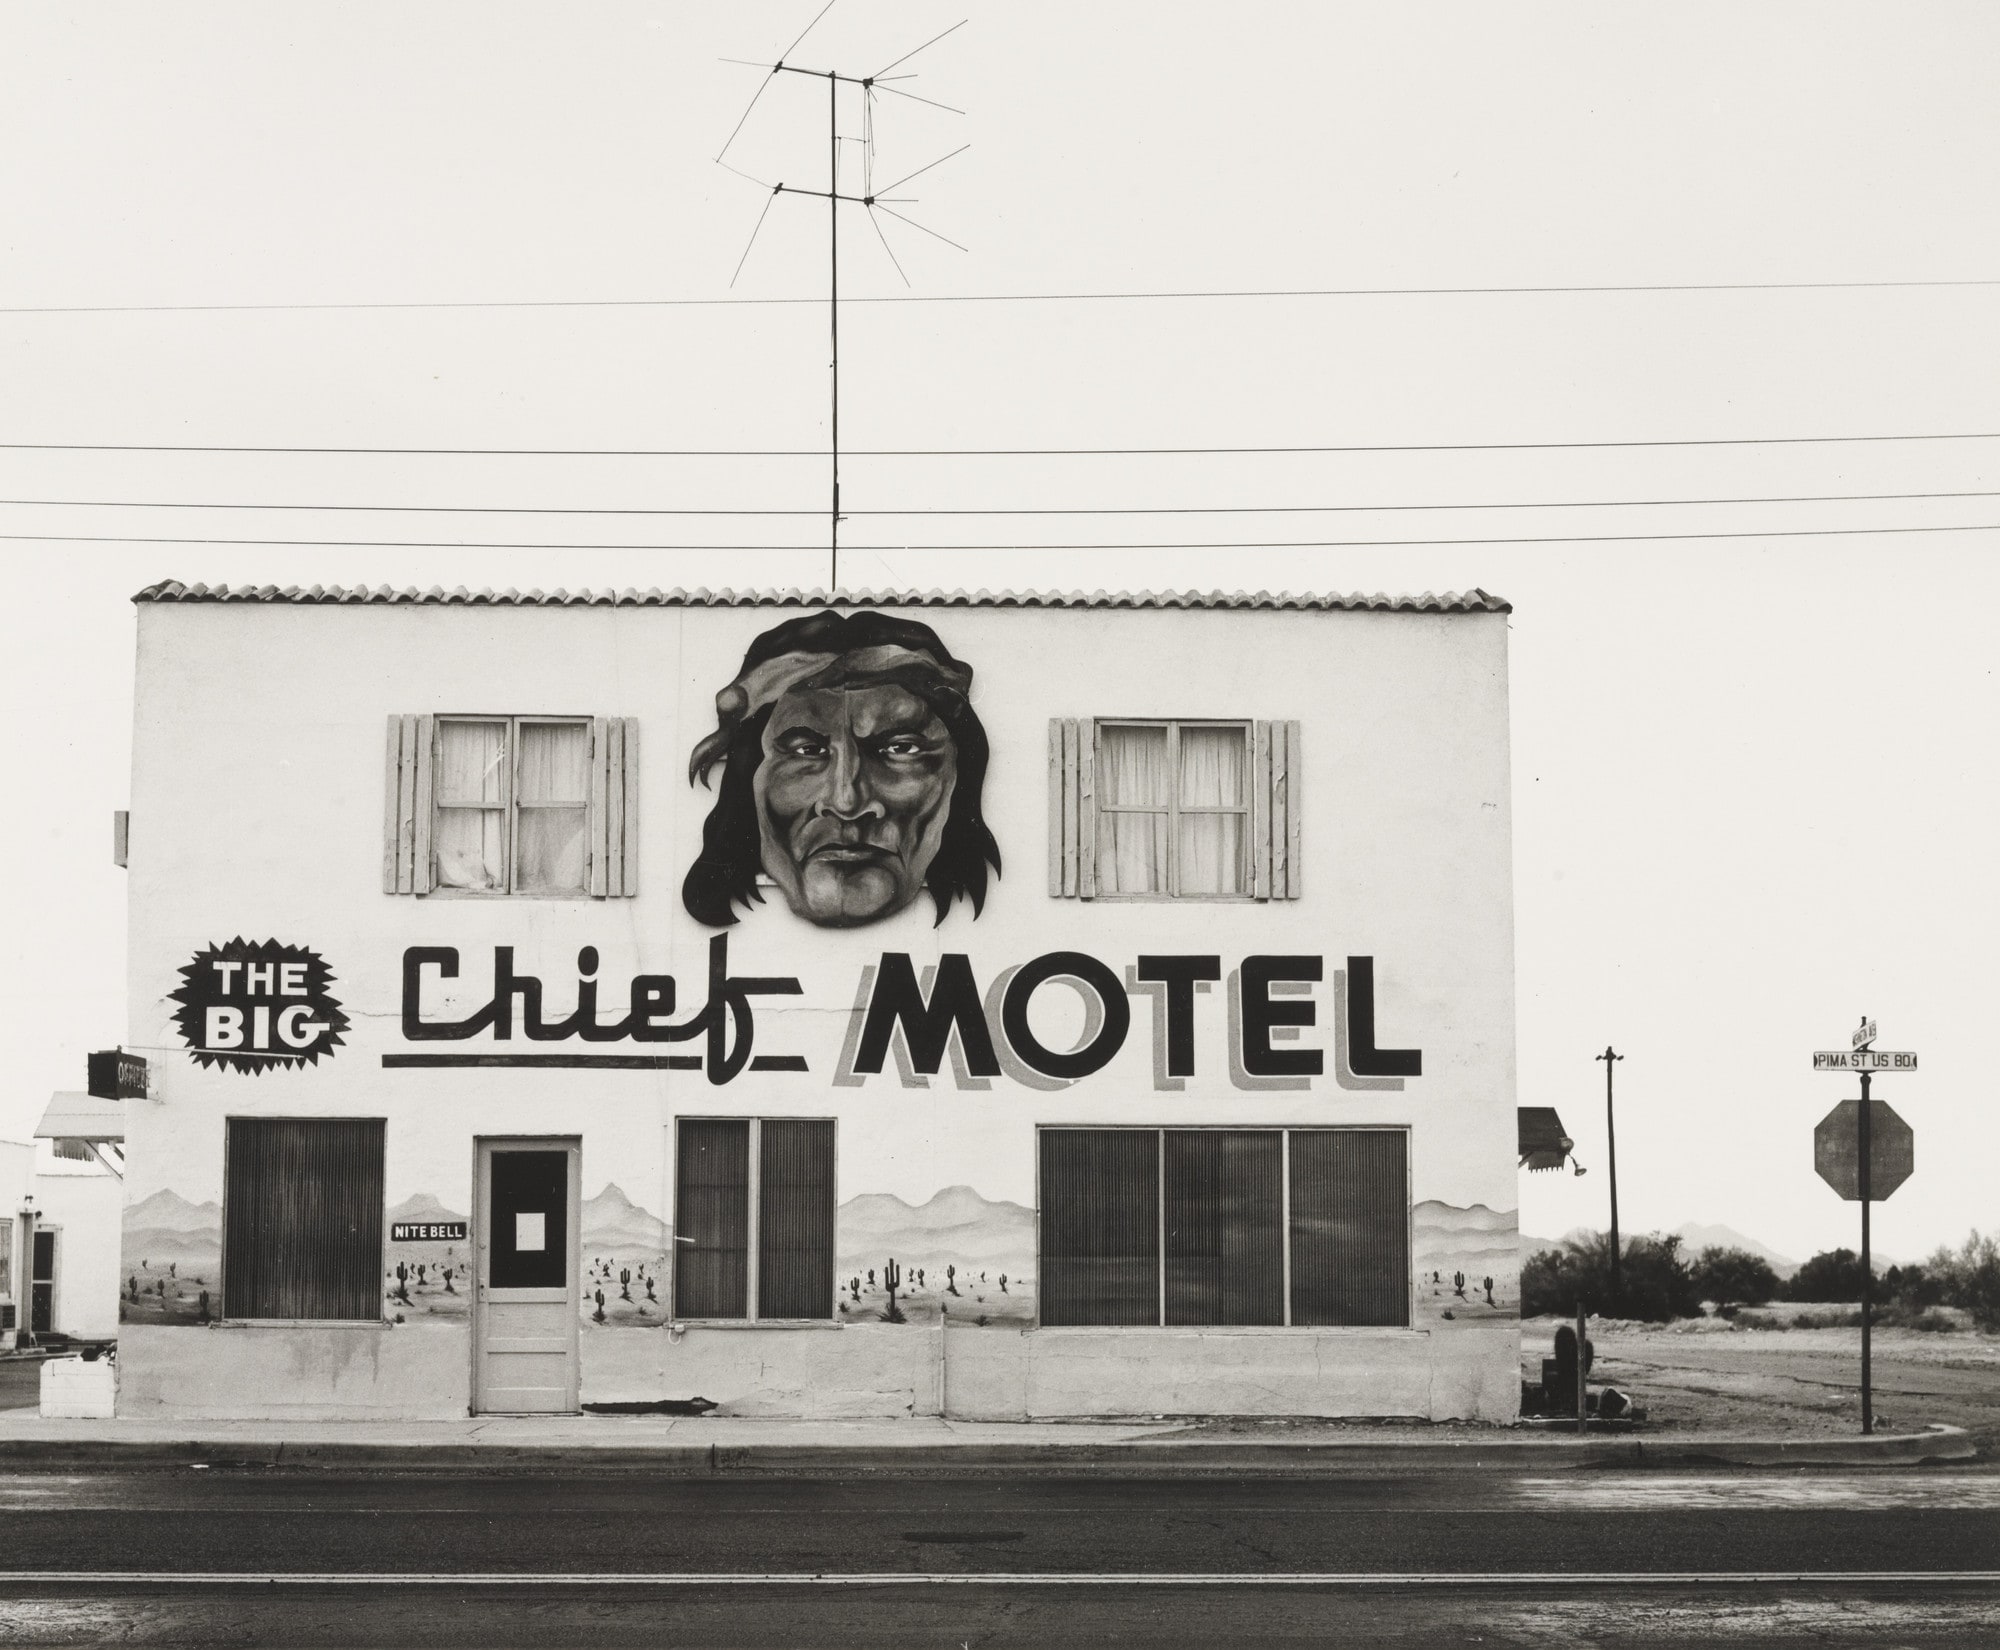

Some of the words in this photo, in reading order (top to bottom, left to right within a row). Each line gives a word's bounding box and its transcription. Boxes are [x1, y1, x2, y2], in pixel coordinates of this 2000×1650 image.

[212, 961, 308, 996] THE
[402, 931, 804, 1086] Chief
[850, 951, 1422, 1079] MOTEL
[205, 1006, 330, 1049] BIG
[1818, 1054, 1847, 1067] PIMA
[1851, 1054, 1867, 1067] ST
[1872, 1054, 1889, 1067] US
[395, 1225, 427, 1238] NITE
[430, 1225, 462, 1238] BELL
